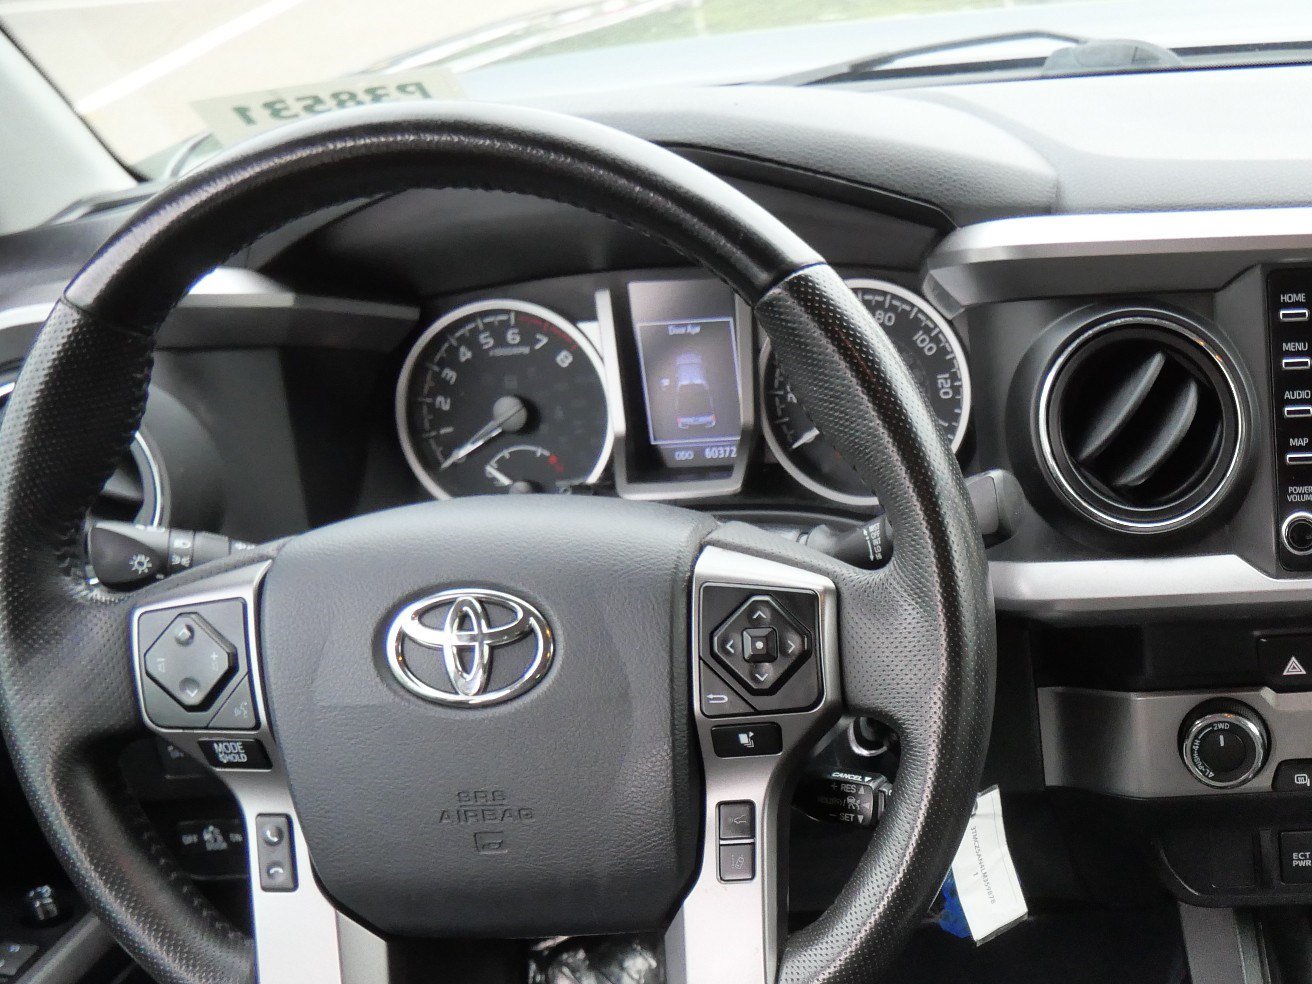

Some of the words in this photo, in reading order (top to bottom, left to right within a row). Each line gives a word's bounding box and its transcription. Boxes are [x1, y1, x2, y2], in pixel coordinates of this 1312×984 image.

[1281, 293, 1306, 303] HOME
[478, 332, 494, 349] 5
[506, 328, 521, 344] 6
[534, 332, 549, 350] 7
[912, 330, 937, 356] 100
[1282, 342, 1308, 351] MENU
[555, 350, 573, 368] 8
[937, 373, 953, 399] 120
[1284, 390, 1311, 400] AUDIO
[1289, 438, 1309, 447] MAP
[1288, 485, 1312, 493] POWER
[1213, 723, 1230, 731] 2WD
[214, 742, 245, 754] MODE
[831, 771, 863, 782] CANCEL
[840, 783, 857, 793] RES
[439, 807, 534, 823] AIRBAG
[839, 813, 855, 822] SET
[1292, 852, 1311, 860] ECT
